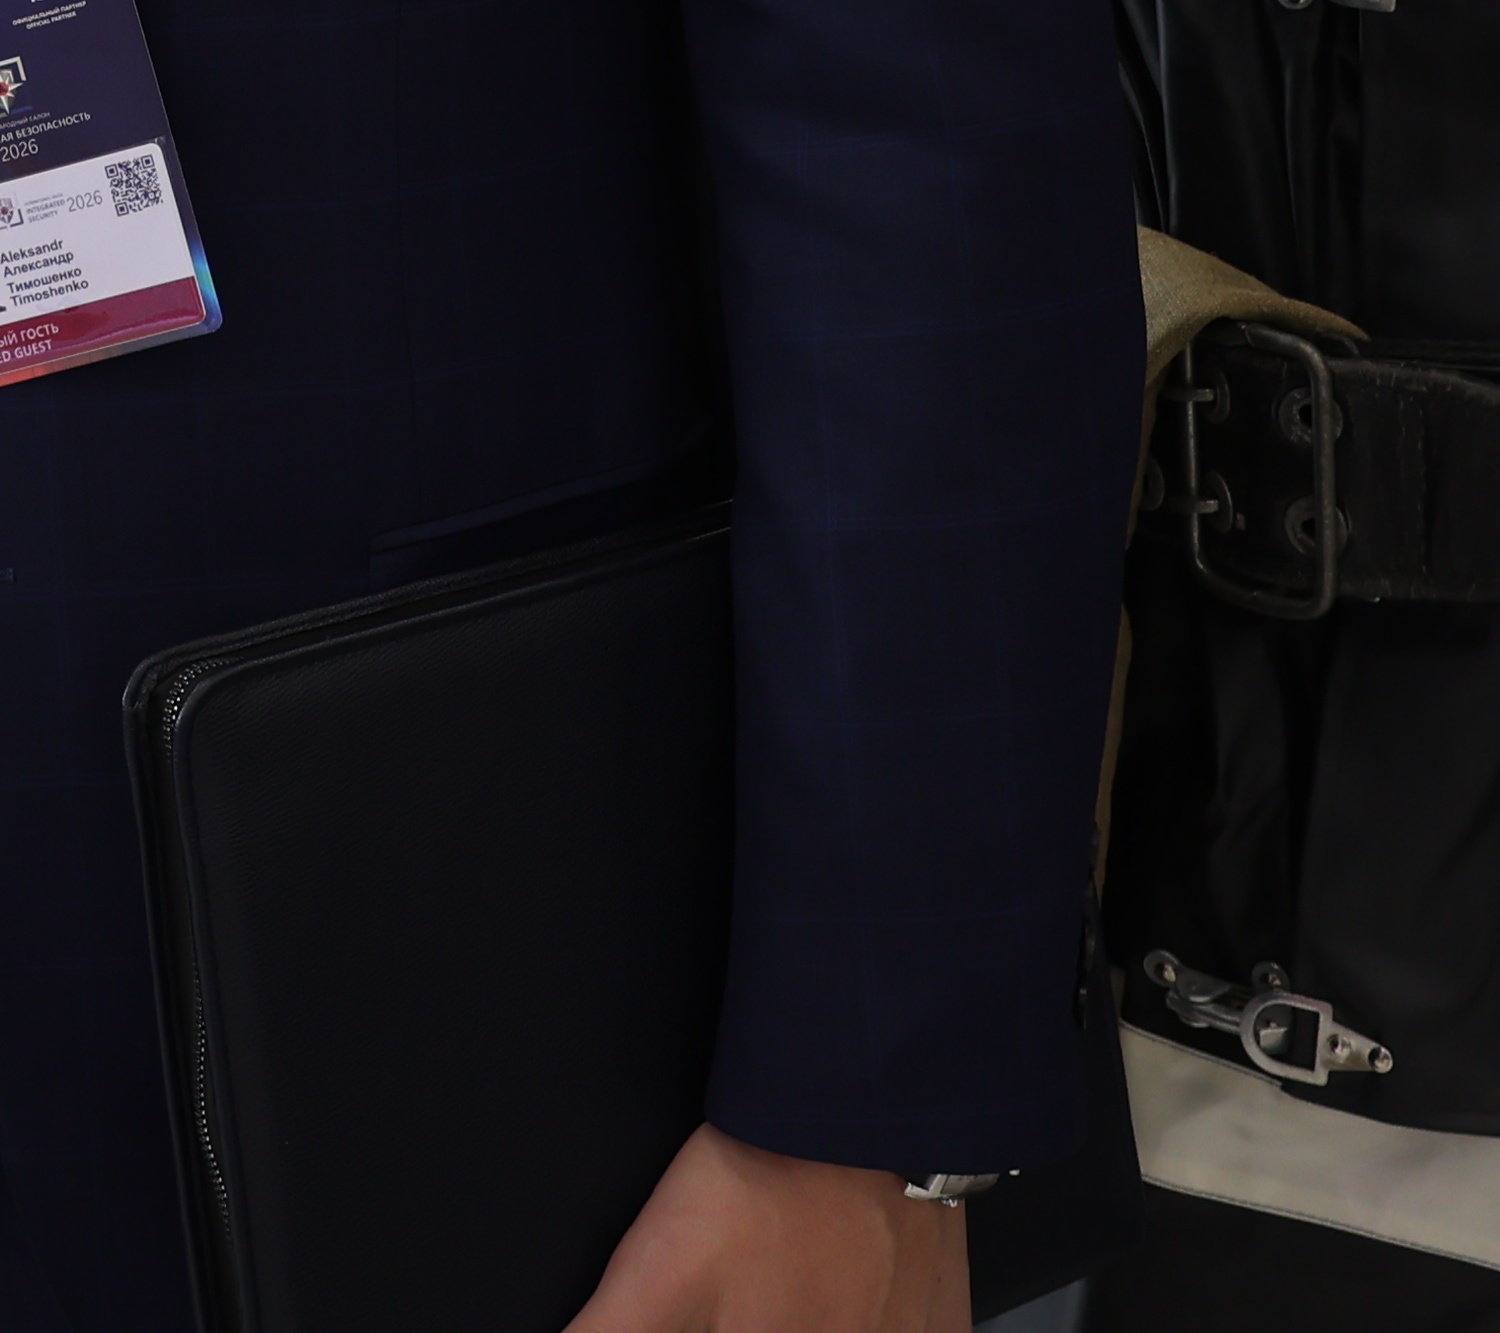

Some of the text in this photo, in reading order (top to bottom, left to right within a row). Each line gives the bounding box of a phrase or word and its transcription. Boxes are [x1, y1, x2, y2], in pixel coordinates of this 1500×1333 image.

[12, 6, 60, 26] ОФИЦИАЛЬНЫЙ
[26, 11, 77, 30] OFFICIAL PARTNER
[15, 111, 91, 140] БЕЗОПАСНОСТЬ
[0, 138, 39, 163] 2026
[26, 198, 66, 214] INTEGRATED
[66, 190, 103, 212] 2026
[0, 238, 64, 264] Aleksandr
[3, 250, 75, 278] Александр
[6, 266, 83, 294] Тимошенко
[10, 279, 90, 307] Timoshenko
[20, 321, 60, 345] ГОСТЬ
[15, 339, 54, 359] GUEST
